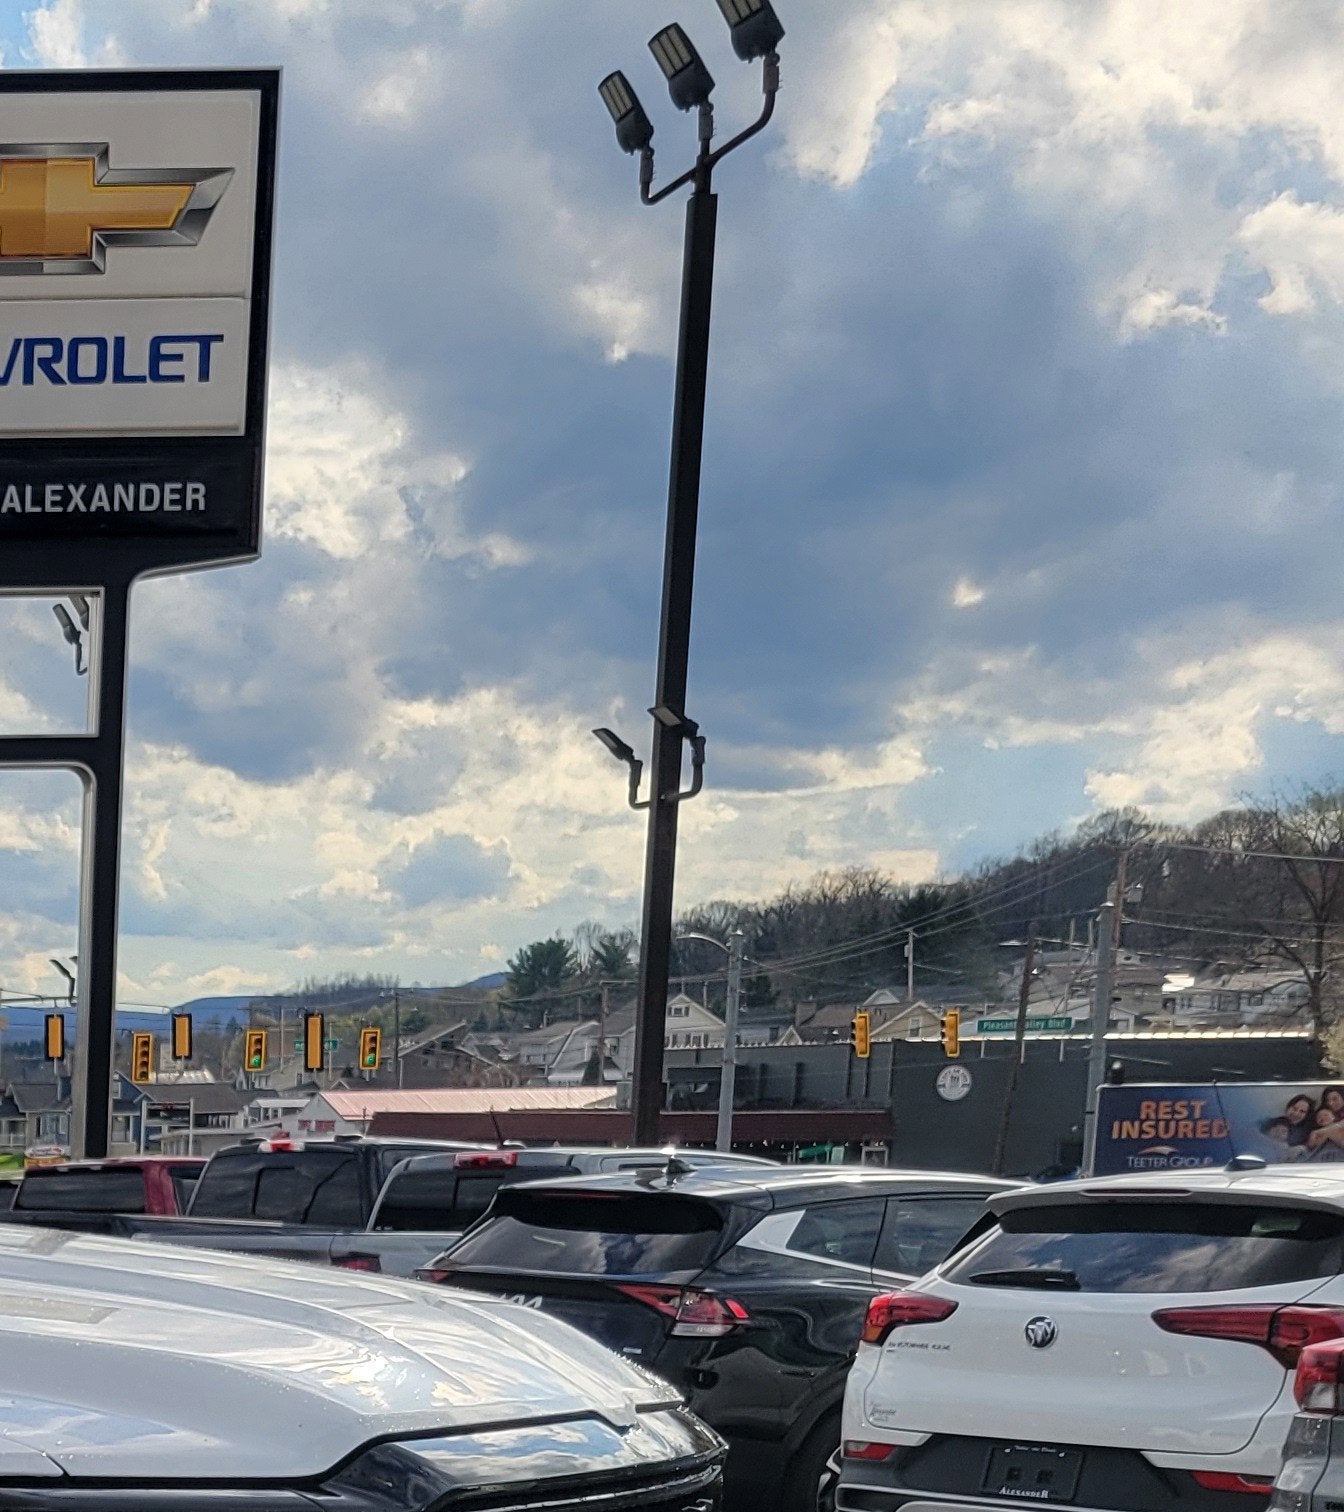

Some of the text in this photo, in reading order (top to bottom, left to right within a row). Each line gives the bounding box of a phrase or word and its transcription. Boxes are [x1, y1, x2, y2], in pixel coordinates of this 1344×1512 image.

[0, 482, 207, 513] ALEXANDER
[1140, 1100, 1206, 1120] REST
[1112, 1120, 1230, 1139] INSURED
[1127, 1156, 1213, 1168] TEETER GROUP
[999, 1486, 1048, 1499] ALEXANDER
